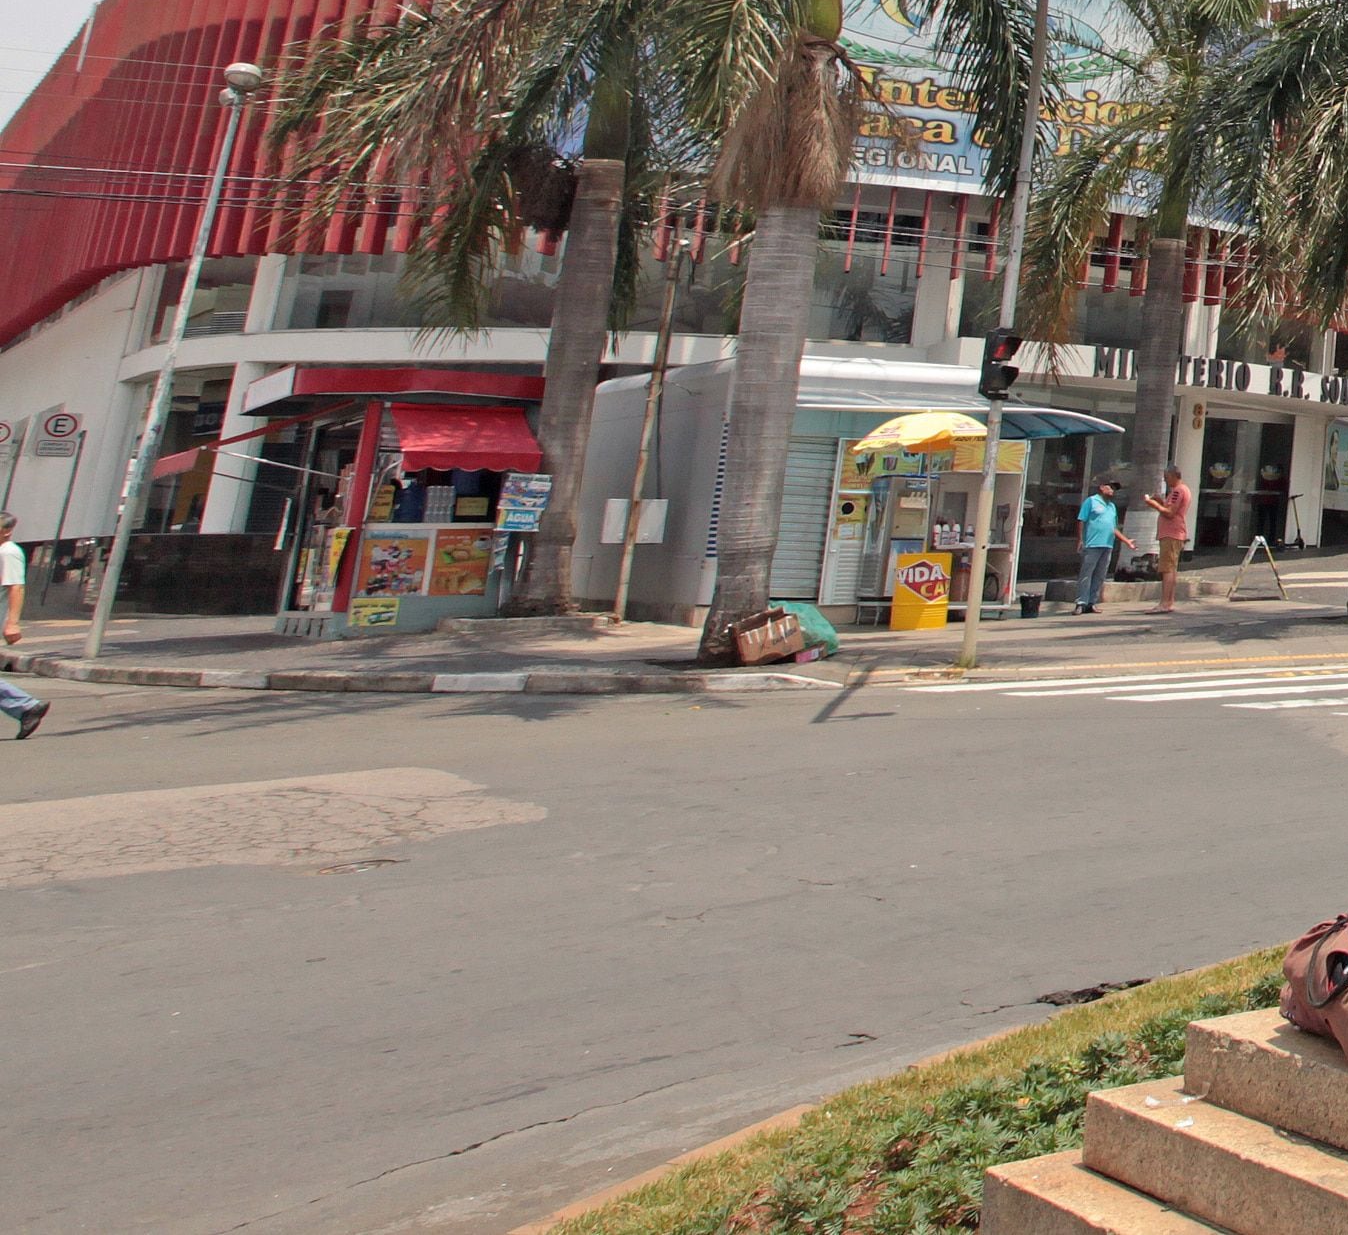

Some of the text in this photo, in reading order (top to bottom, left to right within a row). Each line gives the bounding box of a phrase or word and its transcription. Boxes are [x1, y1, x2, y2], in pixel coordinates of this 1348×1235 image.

[851, 147, 974, 176] EGIONAL
[53, 418, 69, 433] E
[898, 565, 944, 584] VIDA
